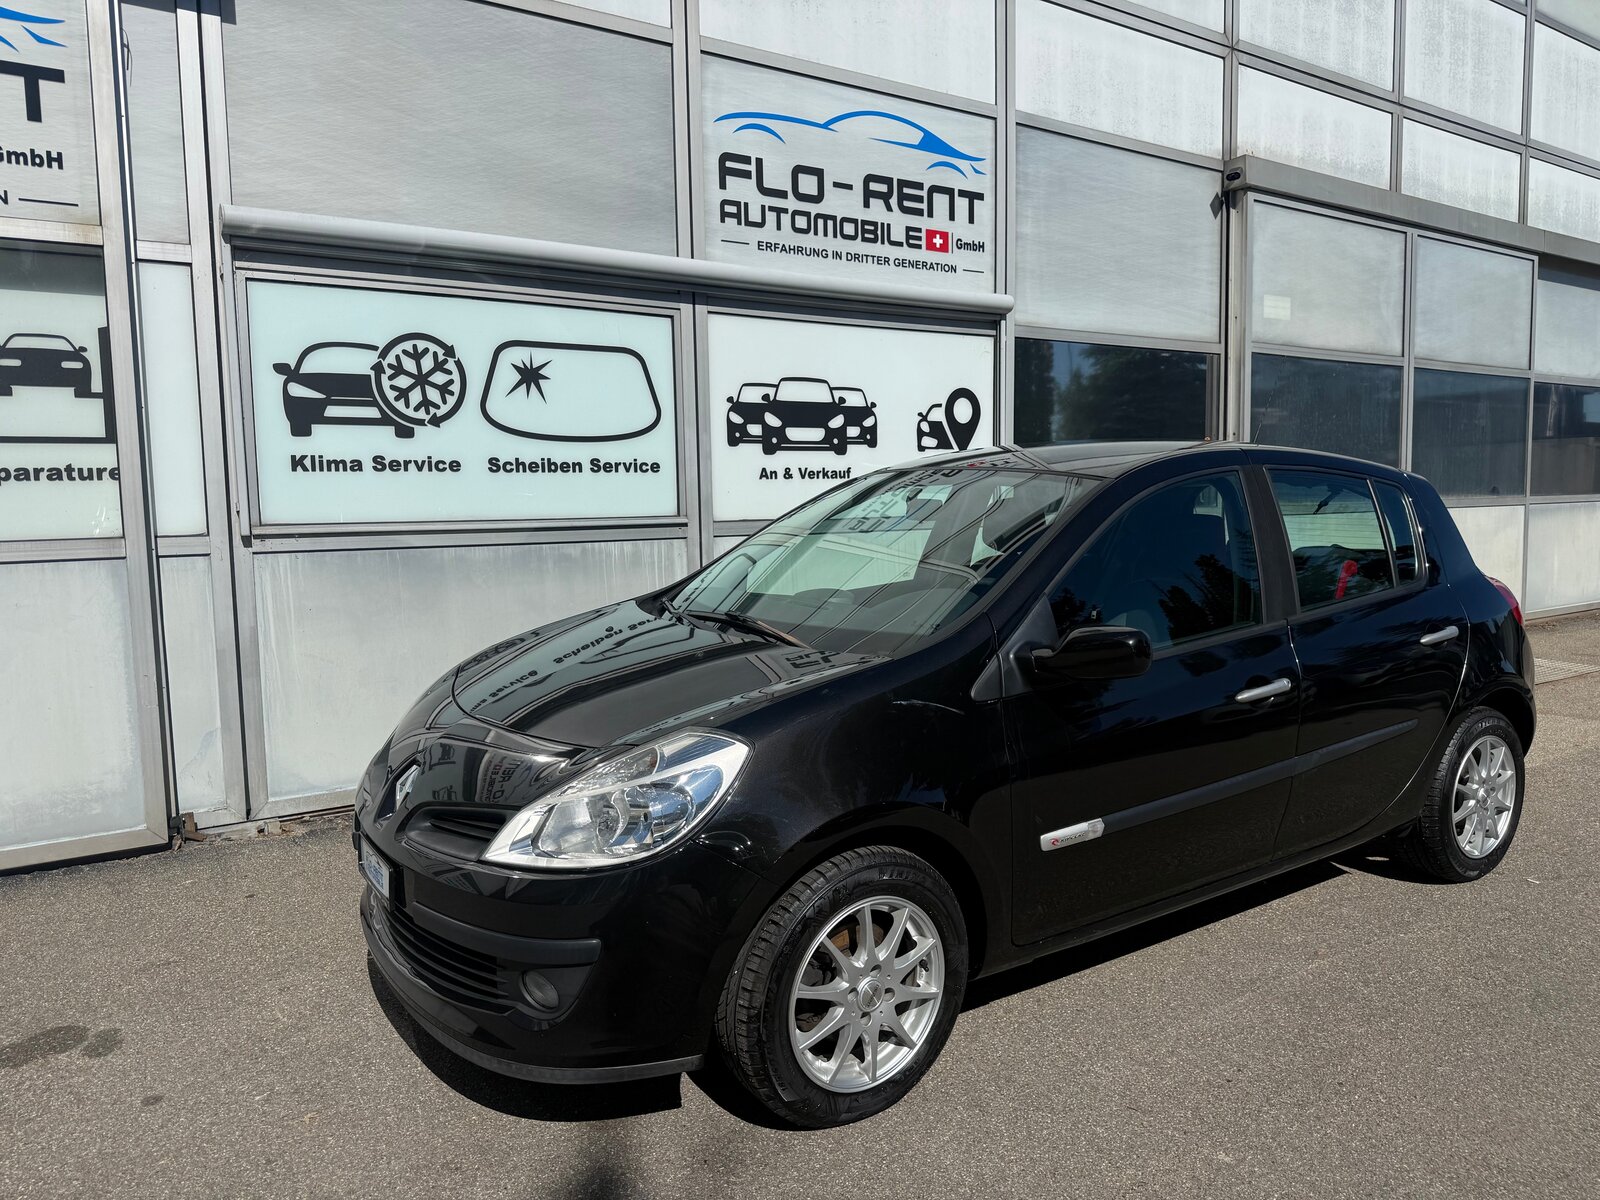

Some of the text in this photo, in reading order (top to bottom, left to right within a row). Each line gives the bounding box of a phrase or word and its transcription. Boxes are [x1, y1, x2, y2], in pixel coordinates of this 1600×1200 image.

[0, 146, 64, 170] mbH
[718, 151, 985, 225] FLO-RENT
[719, 198, 985, 253] AUTOMOBILE GmbH
[757, 240, 957, 274] ERFAHRUNG IN DRITTER GENERATION
[290, 454, 462, 473] Klima Service
[487, 456, 661, 474] Scheiben Service
[758, 467, 852, 480] An & Verkauf
